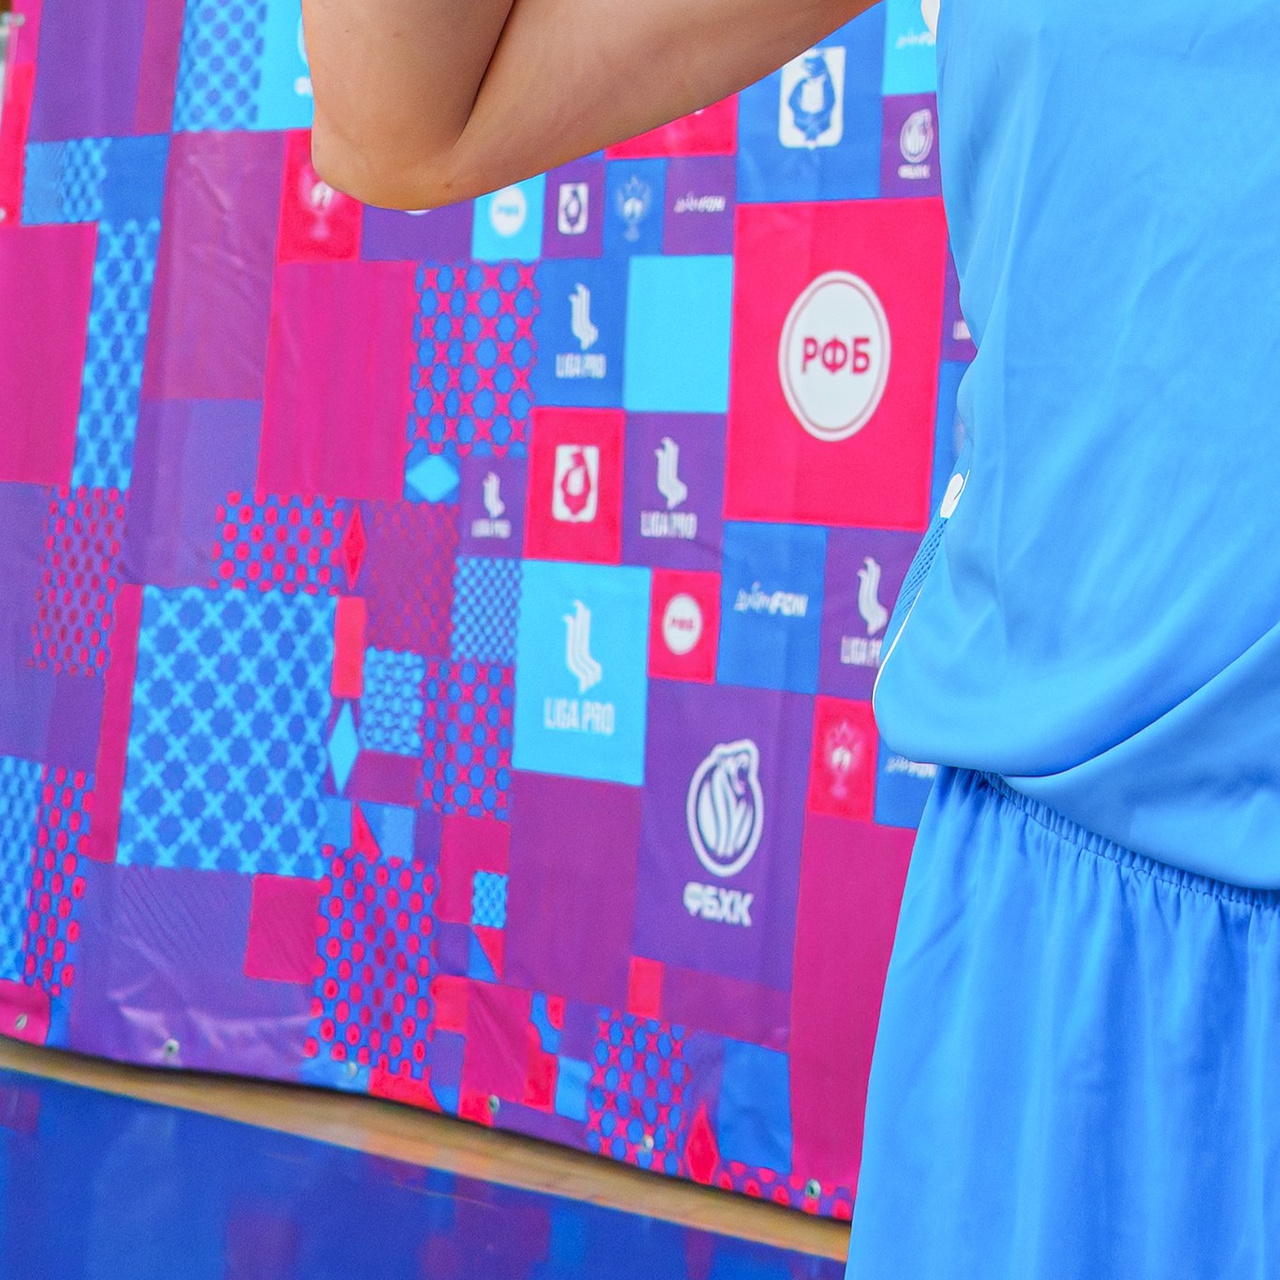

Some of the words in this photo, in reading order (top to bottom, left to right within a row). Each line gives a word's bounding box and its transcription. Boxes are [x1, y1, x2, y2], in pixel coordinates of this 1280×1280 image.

[801, 335, 870, 374] РФБ
[544, 696, 580, 731] LIGA
[581, 700, 616, 735] PRO
[683, 880, 755, 928] ФБХК
